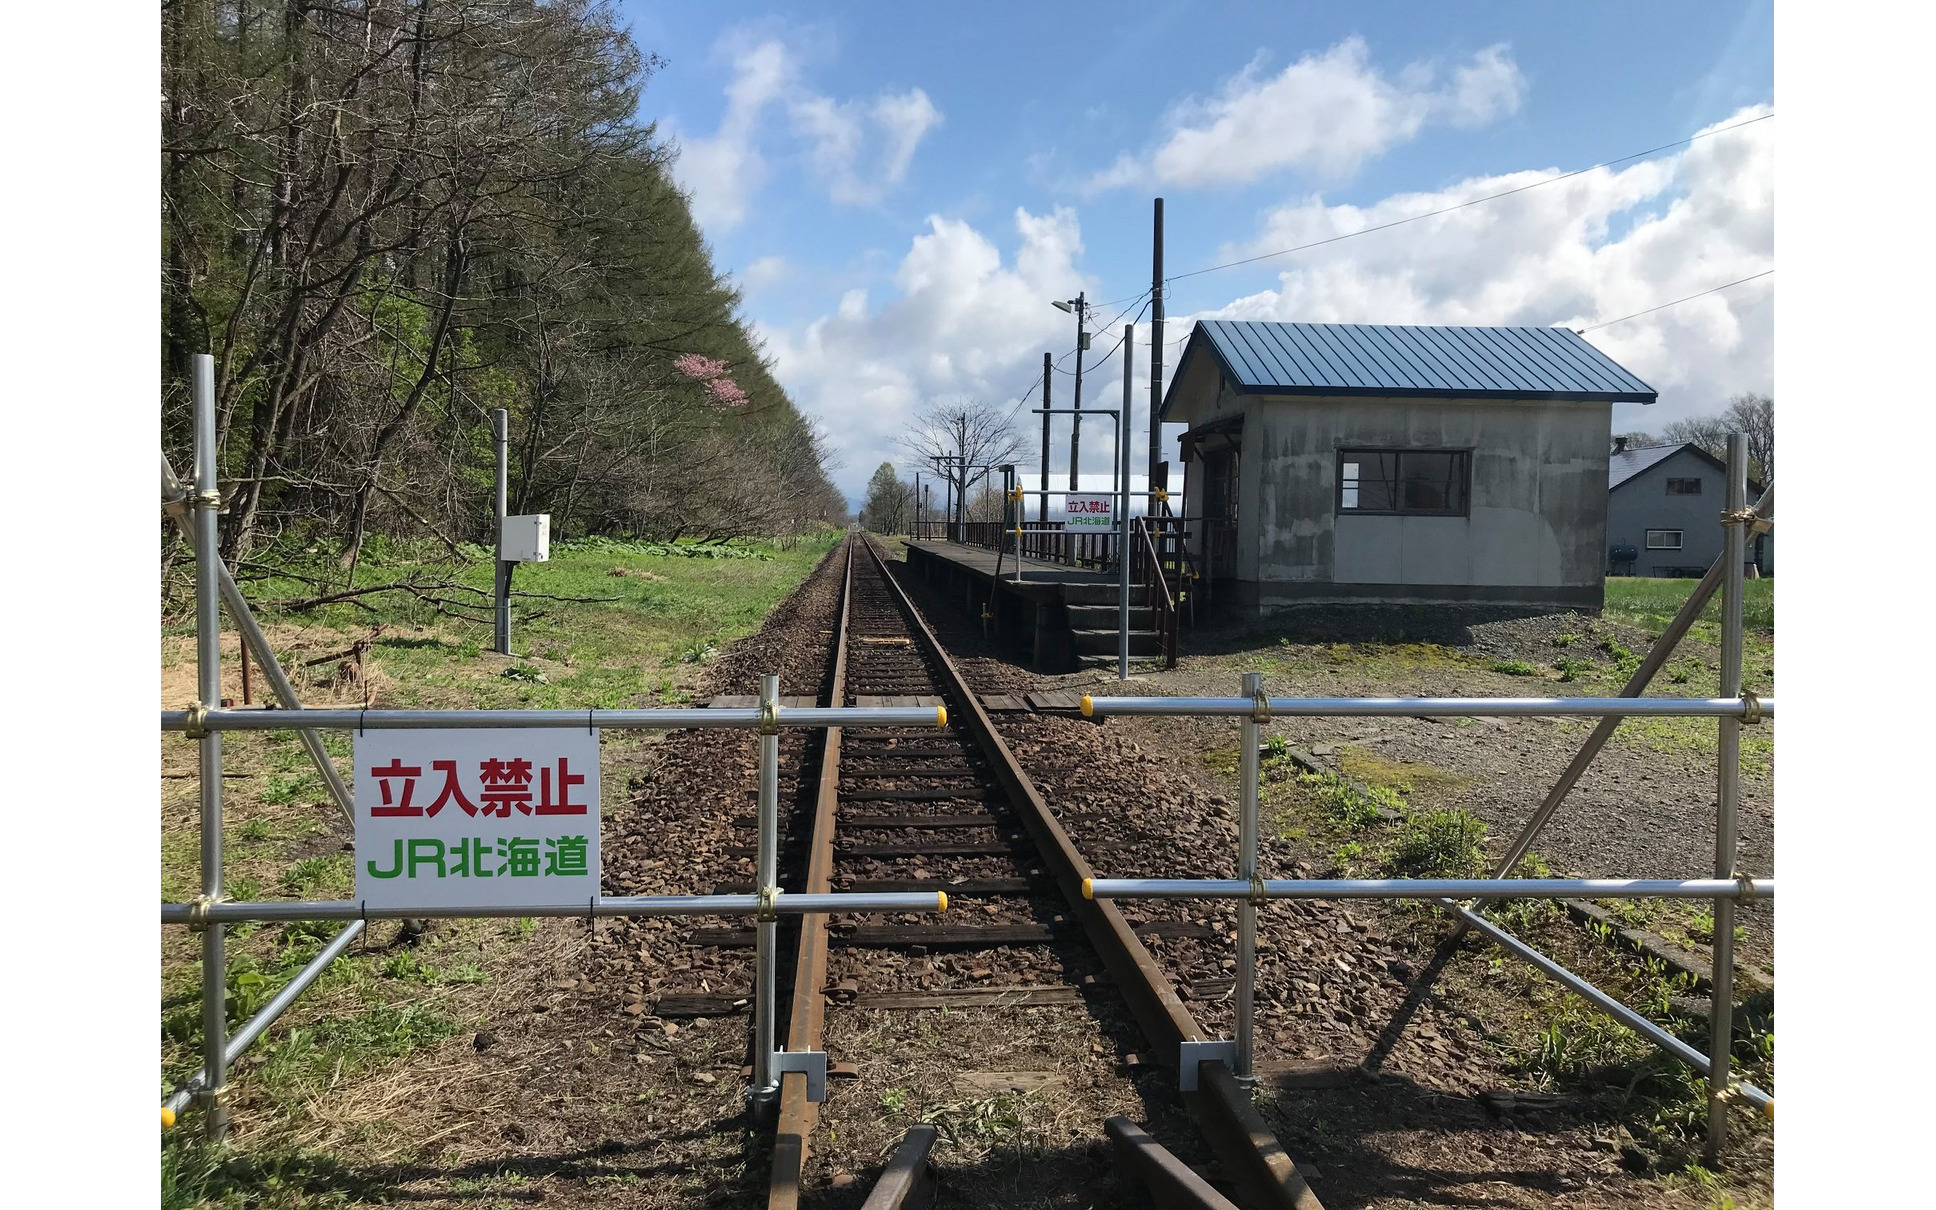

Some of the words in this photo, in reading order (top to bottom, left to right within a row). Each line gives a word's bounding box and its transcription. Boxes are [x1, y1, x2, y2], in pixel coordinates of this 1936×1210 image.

[1067, 516, 1110, 525] JR北海道
[1068, 501, 1110, 513] 立入禁止
[370, 757, 588, 818] 立入禁止
[367, 835, 588, 879] JR北海道
